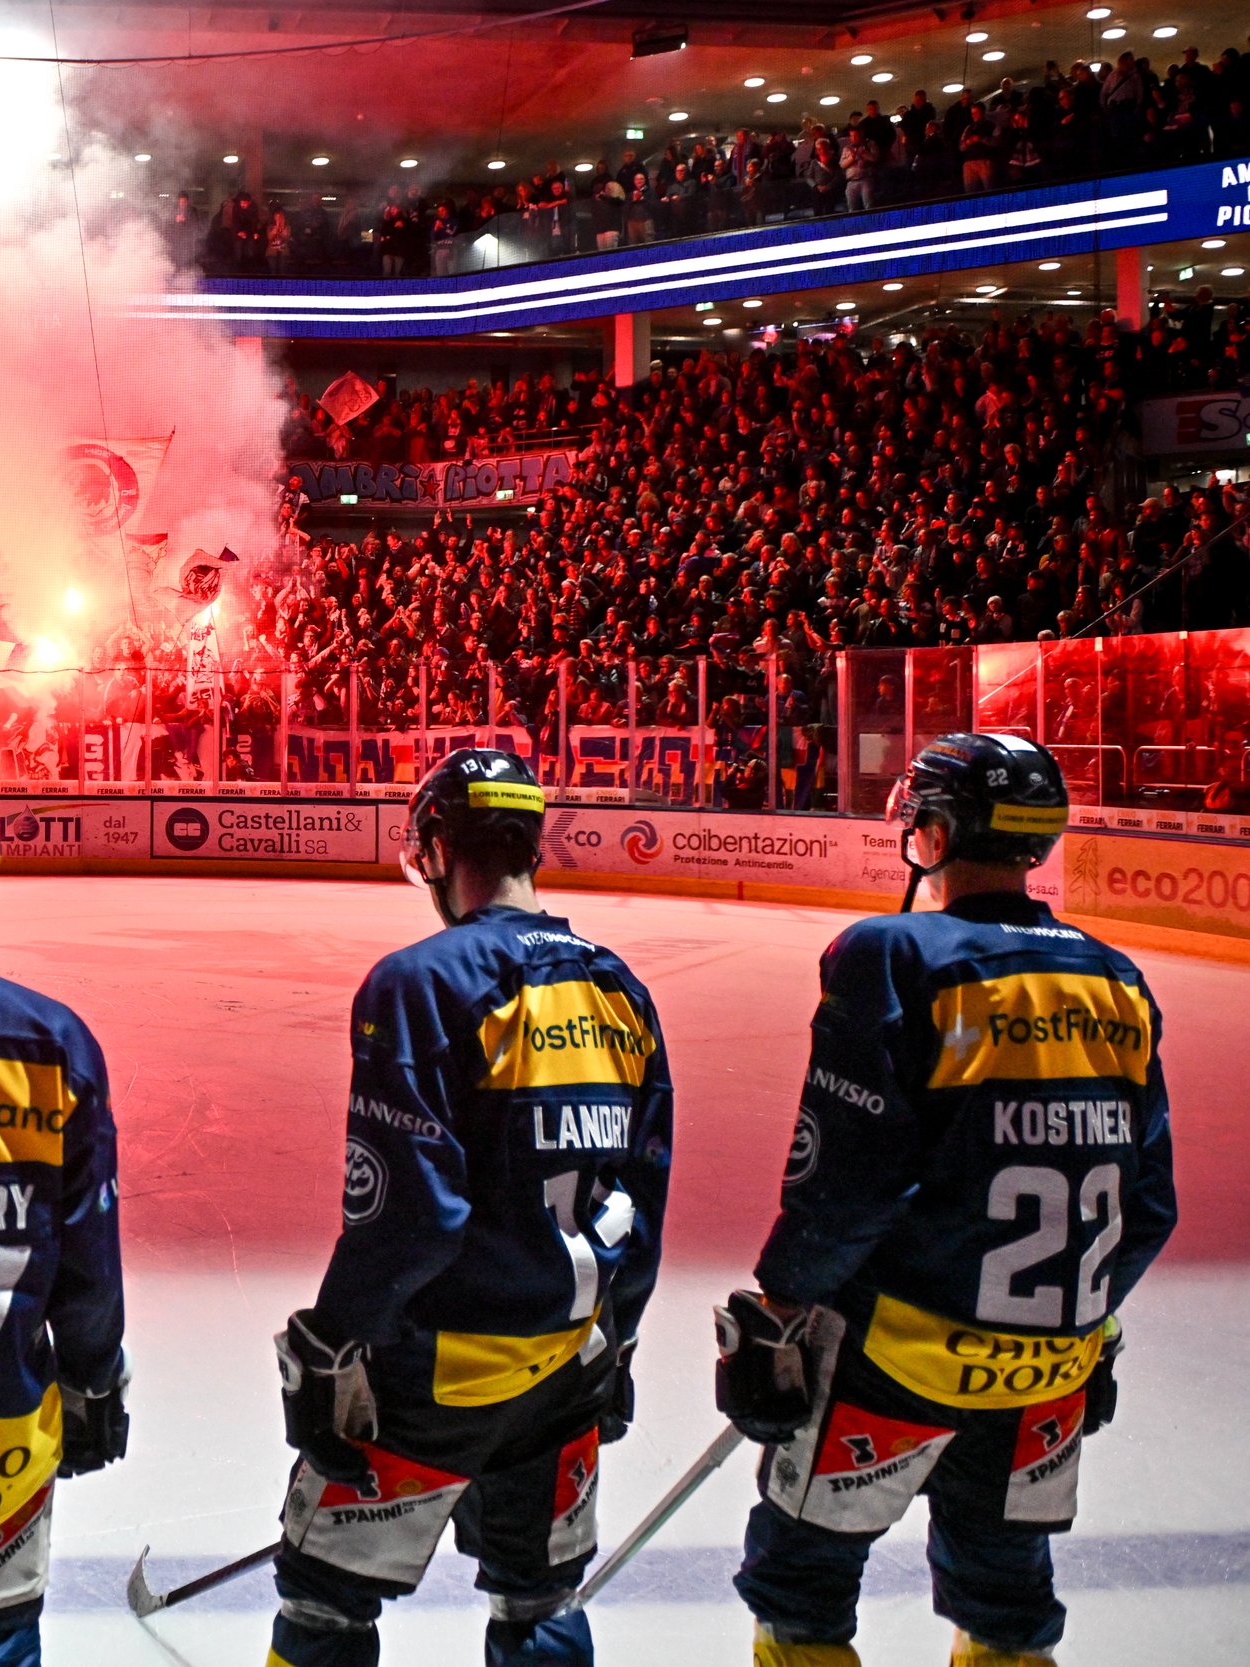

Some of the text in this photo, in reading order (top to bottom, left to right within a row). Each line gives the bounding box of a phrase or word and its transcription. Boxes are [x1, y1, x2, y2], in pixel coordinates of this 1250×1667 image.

[460, 758, 479, 775] 13
[986, 768, 1009, 787] 22
[103, 816, 126, 829] dal
[1079, 816, 1105, 825] FERRARI
[1117, 818, 1143, 827] FERRARI
[1156, 821, 1183, 830] FERRARI
[1197, 824, 1225, 834] FERRARI
[104, 832, 138, 845] 1947
[218, 833, 328, 855] Cavalli sa
[672, 829, 828, 858] coibentazioni
[862, 835, 897, 849] Team
[674, 855, 794, 870] Protezione Antincendio
[861, 866, 906, 882] Agenzia
[1028, 881, 1059, 897] s-sa.ch
[999, 923, 1086, 942] INTERHOCKEY
[533, 1105, 632, 1150] LANDRY
[993, 1100, 1132, 1145] KOSTNER
[975, 1163, 1122, 1328] 22
[827, 1461, 900, 1494] SPAHNI
[332, 1503, 403, 1527] SPAHNI
